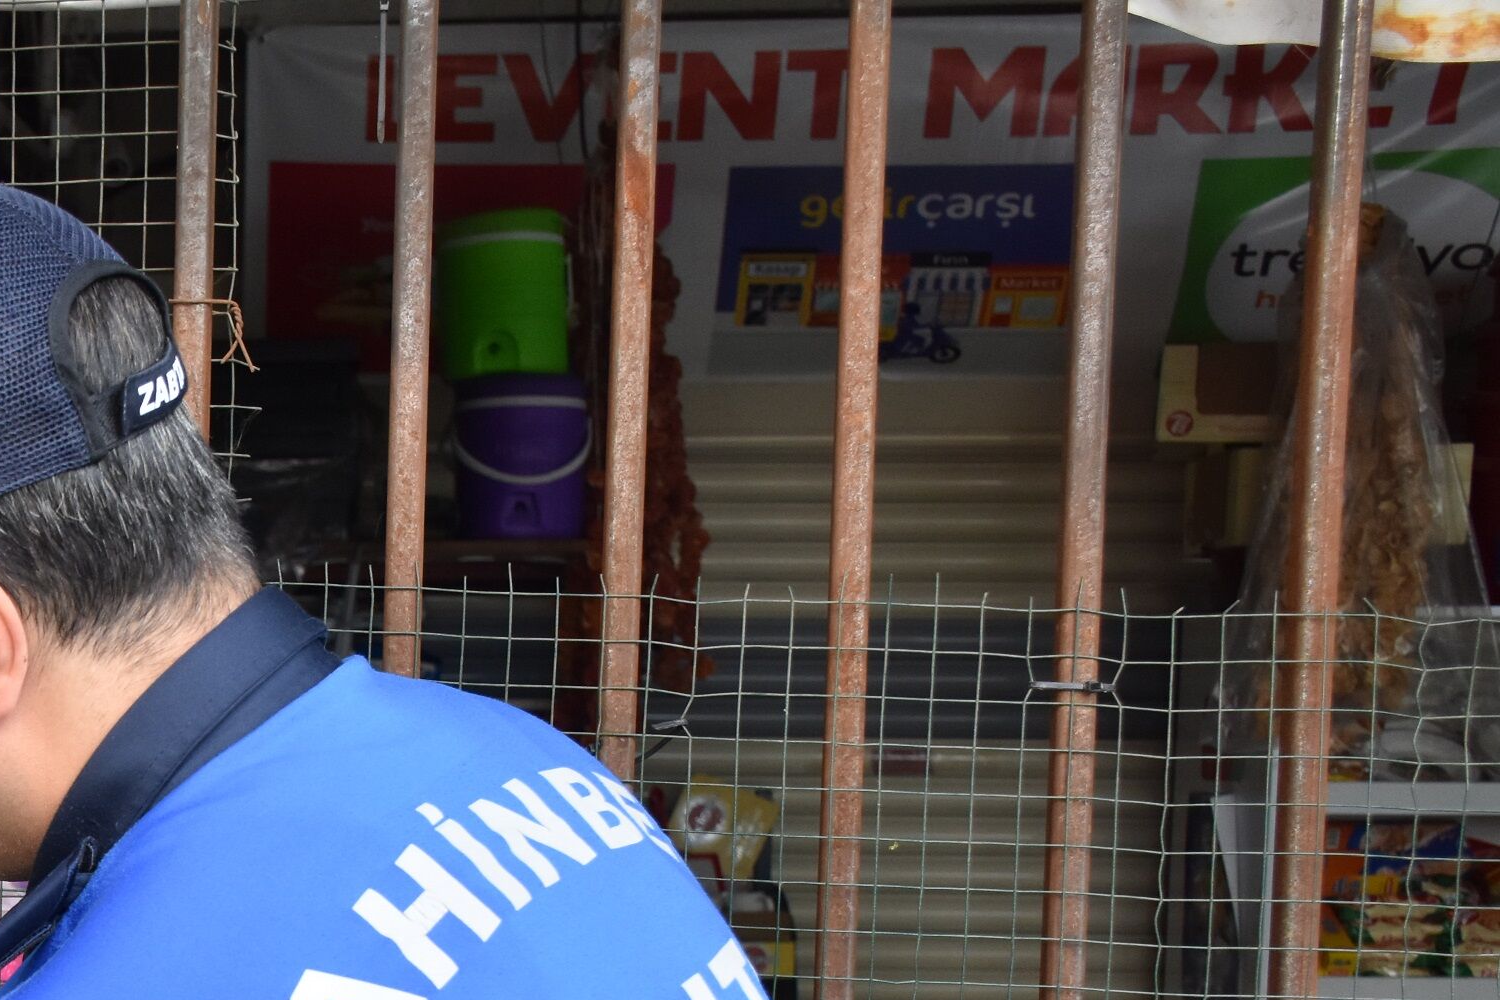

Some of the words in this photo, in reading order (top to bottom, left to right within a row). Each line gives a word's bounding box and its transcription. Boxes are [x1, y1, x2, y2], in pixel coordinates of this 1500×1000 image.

[365, 50, 850, 143] LEVNT
[801, 187, 1037, 229] girçarşı
[1000, 277, 1057, 290] Market
